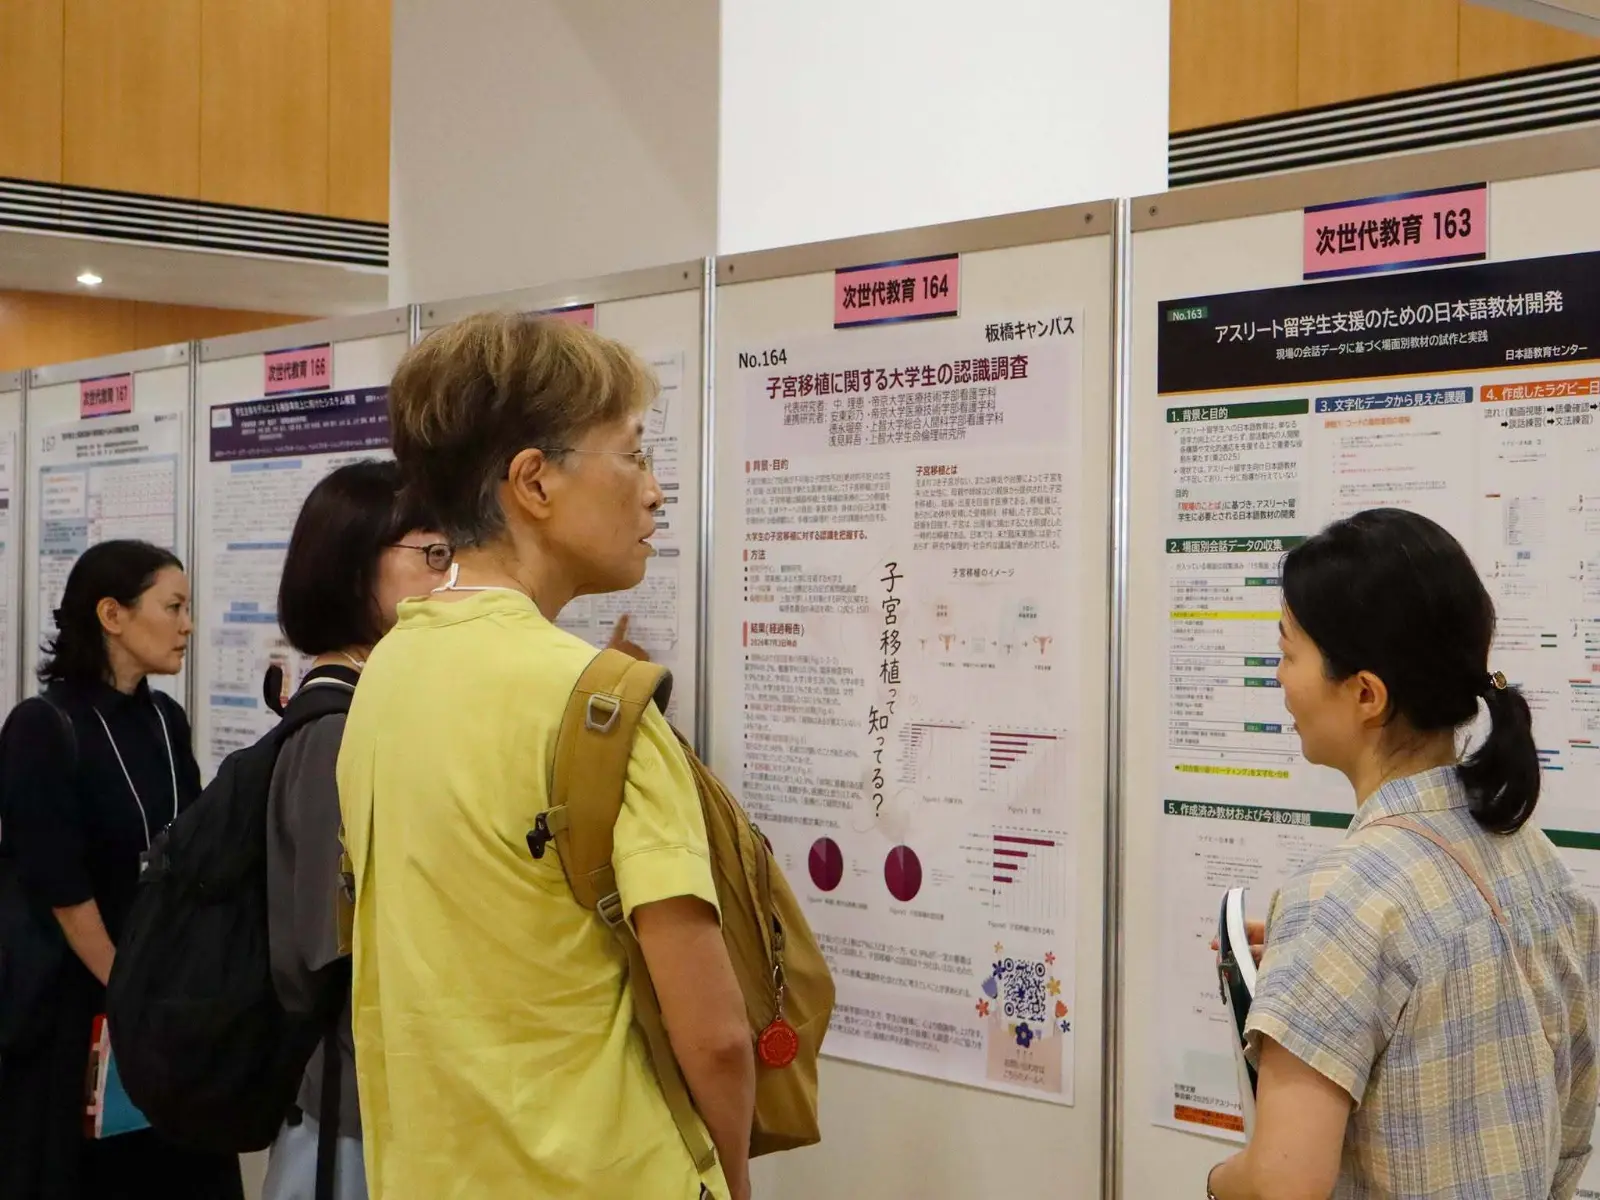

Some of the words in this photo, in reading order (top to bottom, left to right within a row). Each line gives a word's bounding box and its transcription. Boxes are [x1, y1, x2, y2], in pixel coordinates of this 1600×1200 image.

[1315, 214, 1423, 256] 次世代教育
[1433, 207, 1472, 240] 163
[842, 277, 917, 310] 次世代教育
[922, 273, 949, 300] 164
[1171, 308, 1203, 322] No.163
[1214, 290, 1563, 344] アスリート留学生支援のための日本語教材開発
[984, 316, 1075, 343] 板橋キャンパス
[1275, 329, 1489, 361] 現場の会話データに基づく場面別教材の試作と実践
[1504, 343, 1589, 362] 日本語教育センター
[311, 358, 326, 377] 166
[738, 348, 788, 369] No.164
[765, 354, 1029, 400] 子宮移植に関する大学生の認識調査
[1320, 401, 1331, 412] 3.
[1334, 390, 1466, 411] 文字化データから見えた課題
[1486, 389, 1498, 400] 4.
[1501, 380, 1600, 400] 作成したラグビー日
[1183, 407, 1228, 421] 背景と目的
[1170, 541, 1180, 552] 2.
[1183, 539, 1283, 553] 場面別会話データの収集
[879, 561, 904, 715] 子宮移植って
[1168, 804, 1178, 815] 5.
[1180, 803, 1311, 826] 作成済み教材および今後の課題
